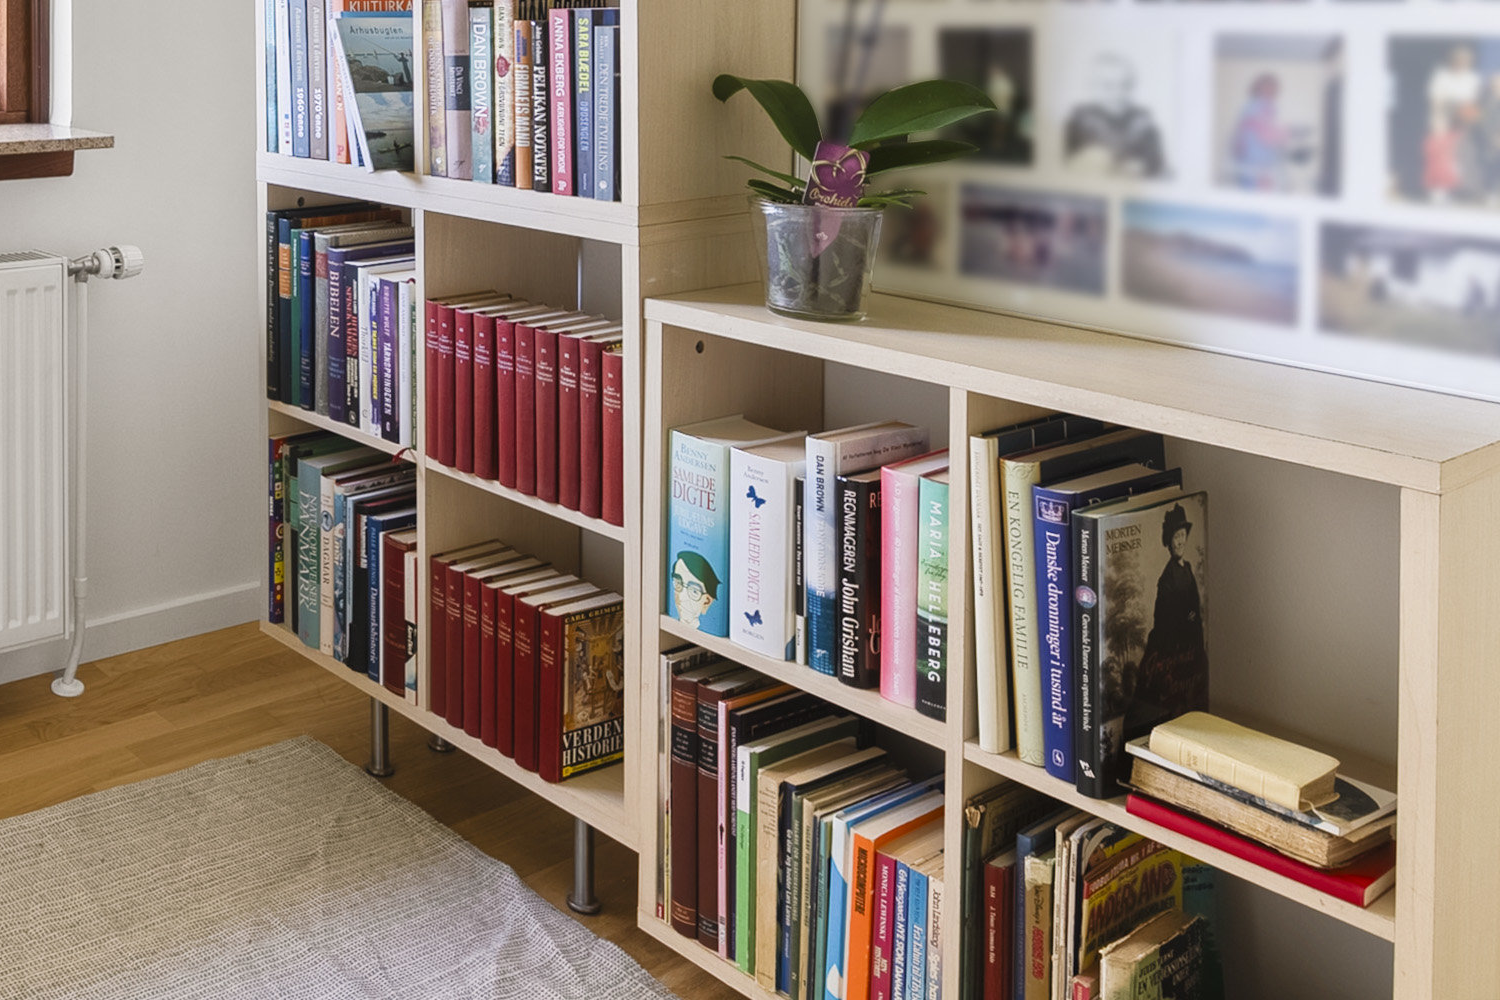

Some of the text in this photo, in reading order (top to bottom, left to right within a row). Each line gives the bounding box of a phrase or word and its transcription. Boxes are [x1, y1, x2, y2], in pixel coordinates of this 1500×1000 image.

[473, 24, 487, 57] DAN
[553, 16, 565, 97] ANNA EKBERG
[578, 17, 589, 93] SARA BLÆDEL
[473, 59, 488, 118] BROWN
[533, 65, 547, 184] PELIKAN NOTATET
[600, 63, 609, 172] DEN TREDJE TVILLING
[329, 270, 340, 338] BIBELEN
[674, 450, 717, 473] ANDERSEN
[674, 466, 717, 492] SAMLEDE
[816, 455, 824, 513] DAN BROWN
[673, 479, 717, 513] DIGTE
[299, 490, 309, 610] DANMARK
[843, 489, 856, 572] REGNMAGEREN
[929, 500, 942, 559] MARIA
[1045, 530, 1062, 581] Danske
[1081, 529, 1089, 582] Morten Meisner
[1105, 524, 1142, 542] MORTEN
[1105, 538, 1142, 556] MEISNER
[322, 536, 330, 585] DAGMAR
[748, 513, 762, 606] SAMLEDE DIGTE
[1008, 490, 1028, 670] EN KONGELIG FAMILIE
[370, 587, 379, 664] Danmarkshistorie
[841, 578, 859, 678] John Grisham
[928, 580, 942, 683] HELLEBERG
[1046, 583, 1063, 659] dronninger
[1051, 668, 1066, 709] tusind
[1052, 711, 1066, 729] år
[879, 899, 887, 941] LEWINSKY
[932, 889, 941, 909] John
[895, 941, 905, 965] STORE
[896, 923, 905, 940] NYE
[913, 924, 924, 940] Fra
